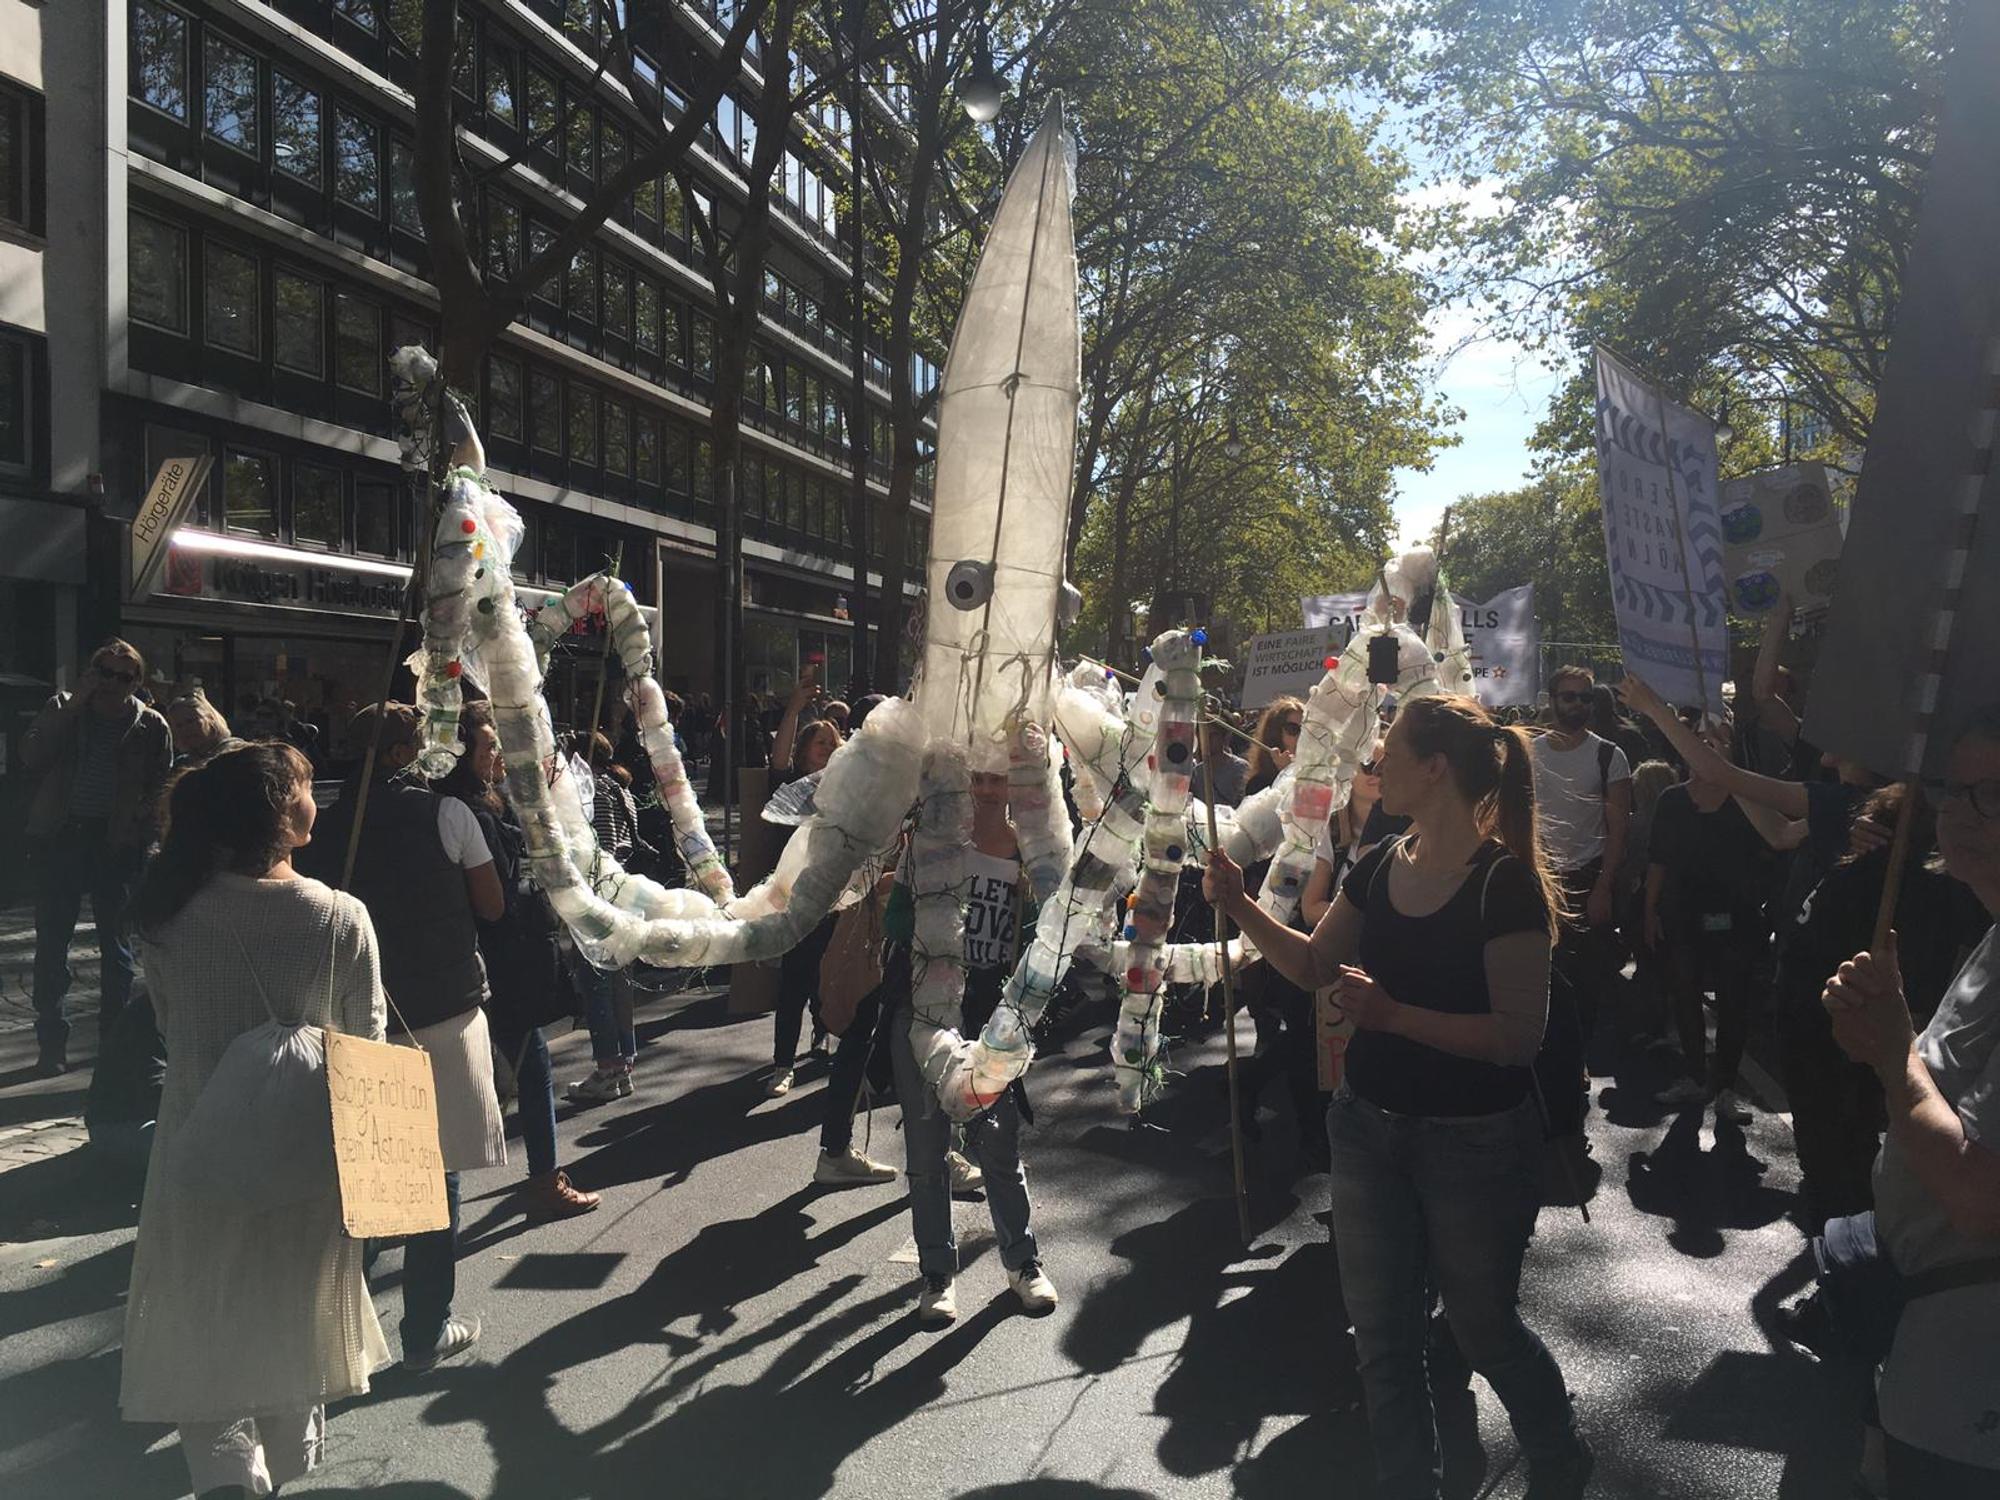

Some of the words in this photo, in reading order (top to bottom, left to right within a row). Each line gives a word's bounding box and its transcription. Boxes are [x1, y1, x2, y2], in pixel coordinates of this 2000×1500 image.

[135, 464, 184, 543] Hörgeräte
[1462, 610, 1499, 629] LLS
[1257, 638, 1283, 651] EINE
[1285, 635, 1317, 648] FAIRE
[1256, 647, 1324, 663] WIRTSCHAFT
[1252, 665, 1269, 677] IST
[1271, 659, 1324, 675] MÖGLICH
[965, 901, 1014, 944] OVE
[964, 938, 1012, 967] ULE
[411, 1084, 428, 1111] an
